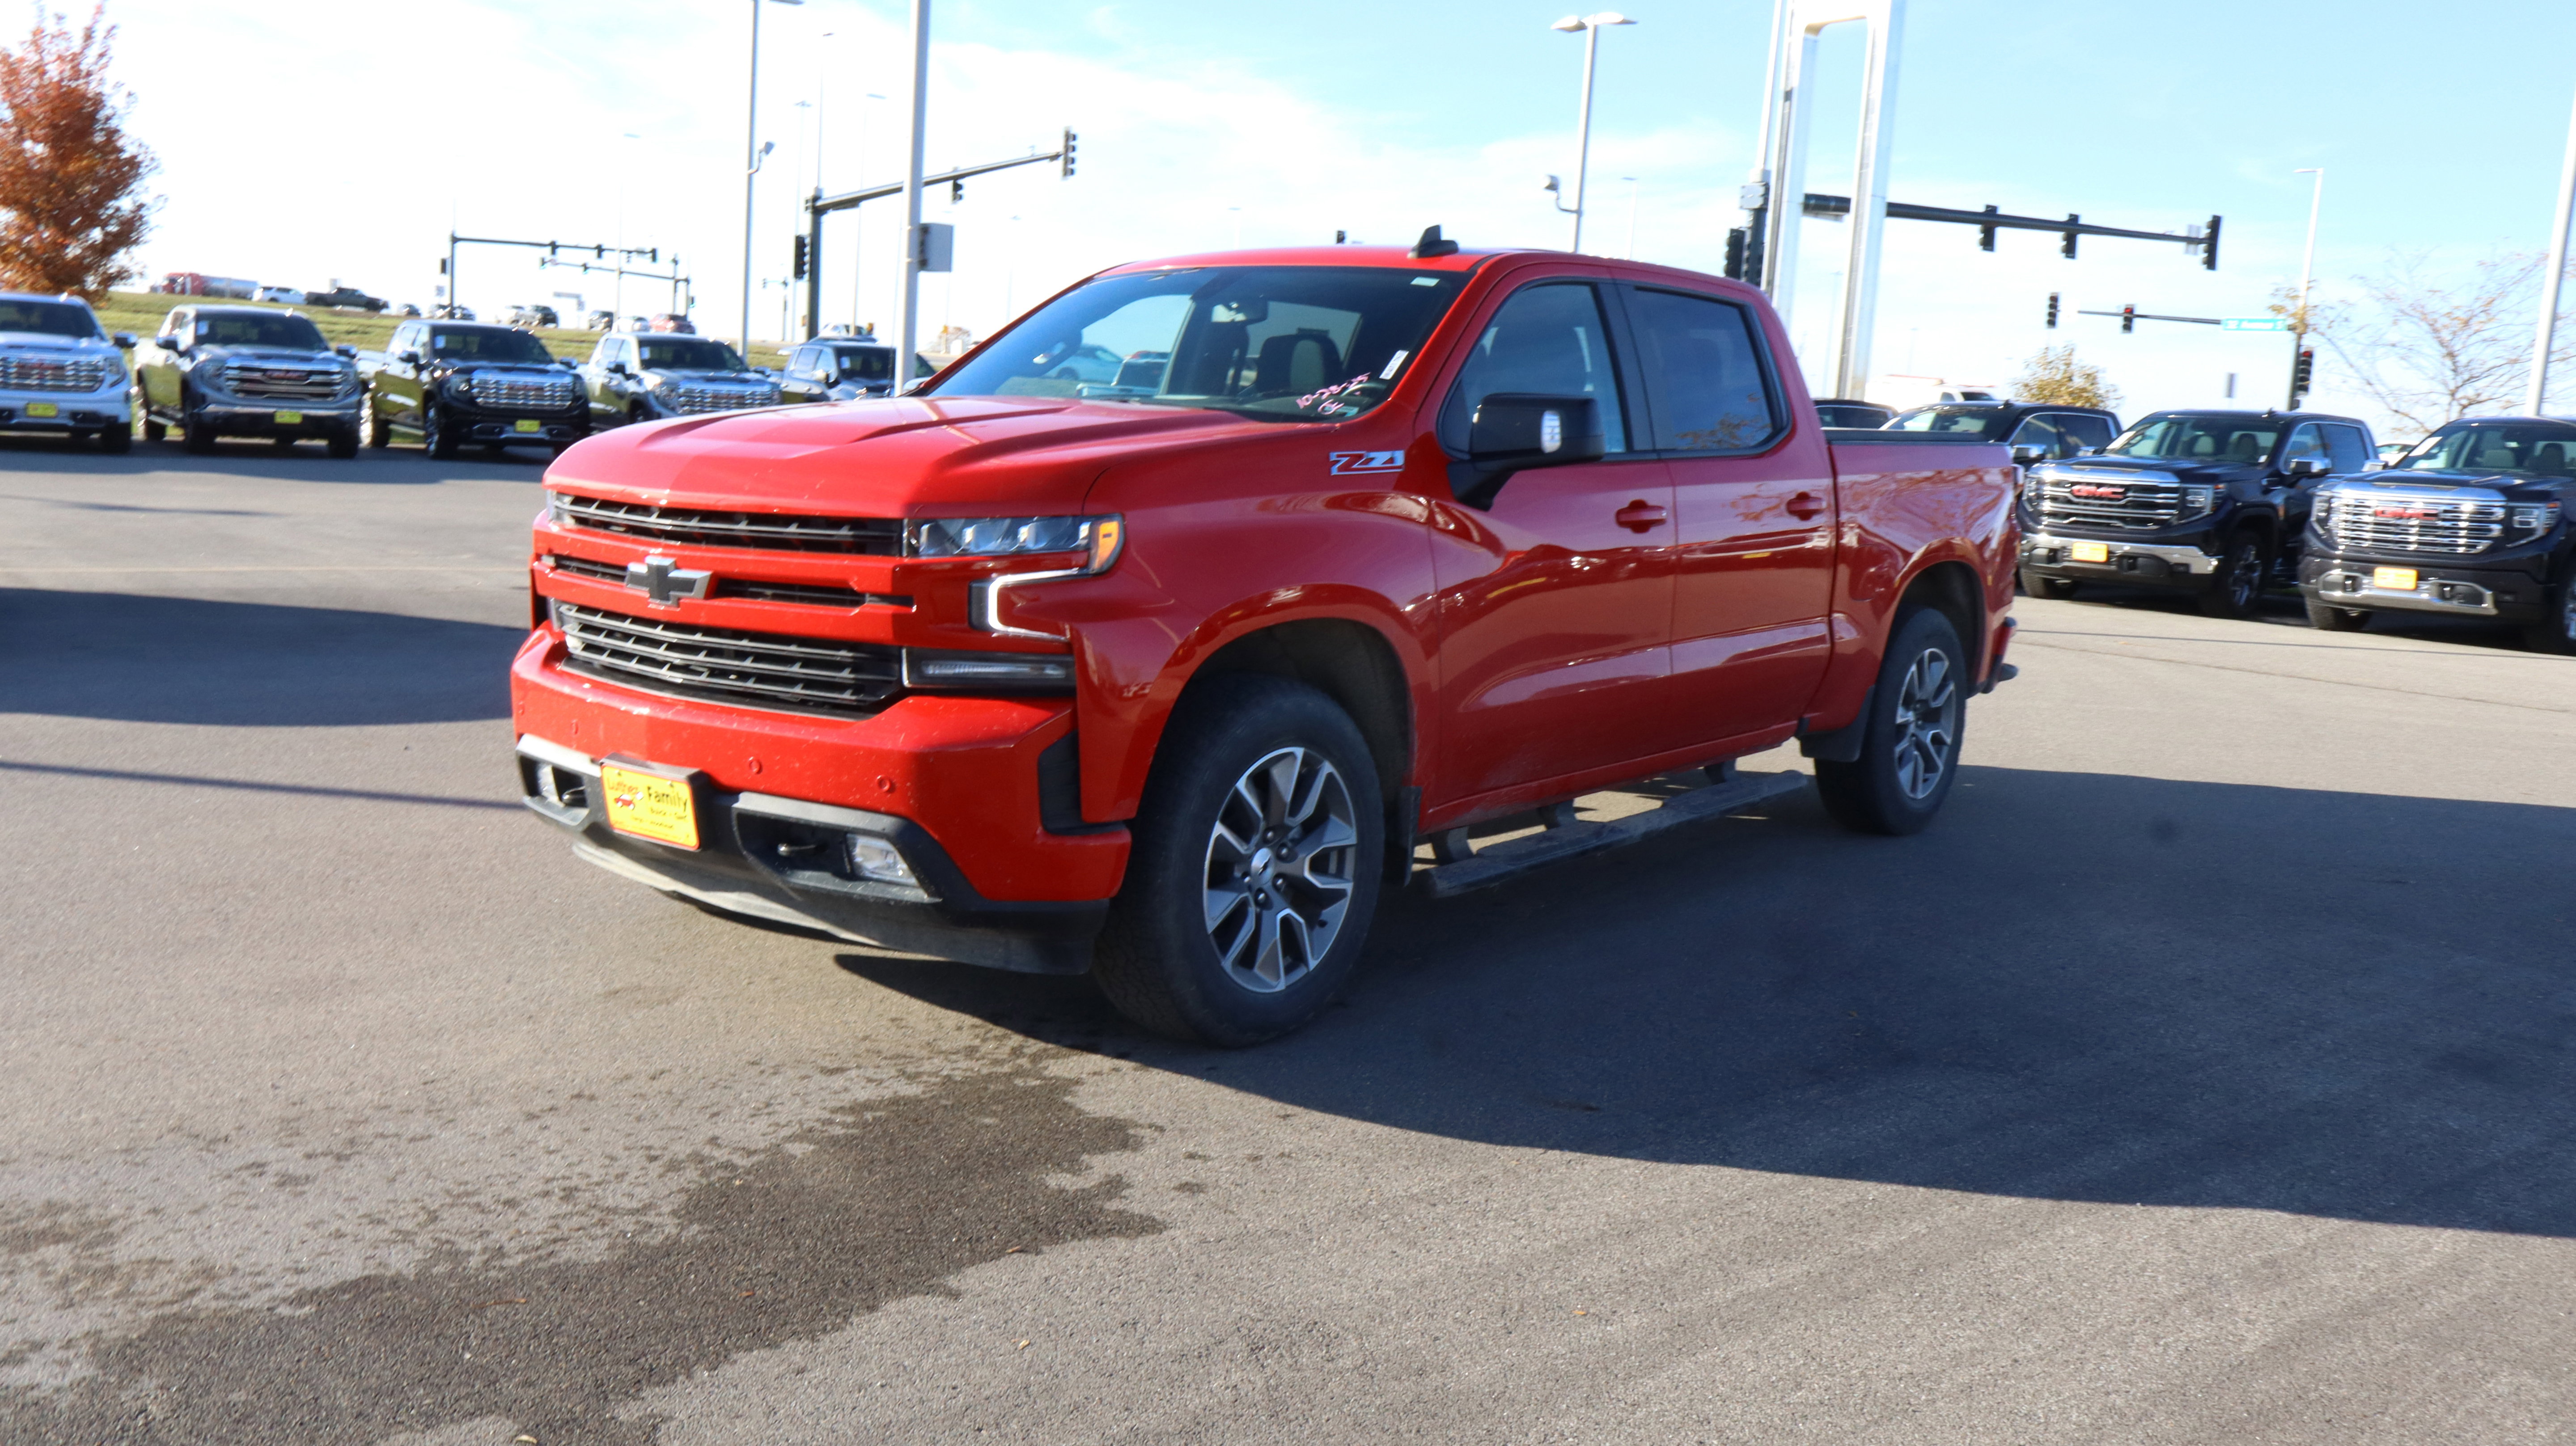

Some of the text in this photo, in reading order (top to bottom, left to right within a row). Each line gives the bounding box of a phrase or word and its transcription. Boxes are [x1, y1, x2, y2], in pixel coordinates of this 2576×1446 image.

[1329, 450, 1405, 475] Z71
[2072, 485, 2125, 499] GMC
[2375, 506, 2440, 521] GMC
[647, 785, 688, 813] Family
